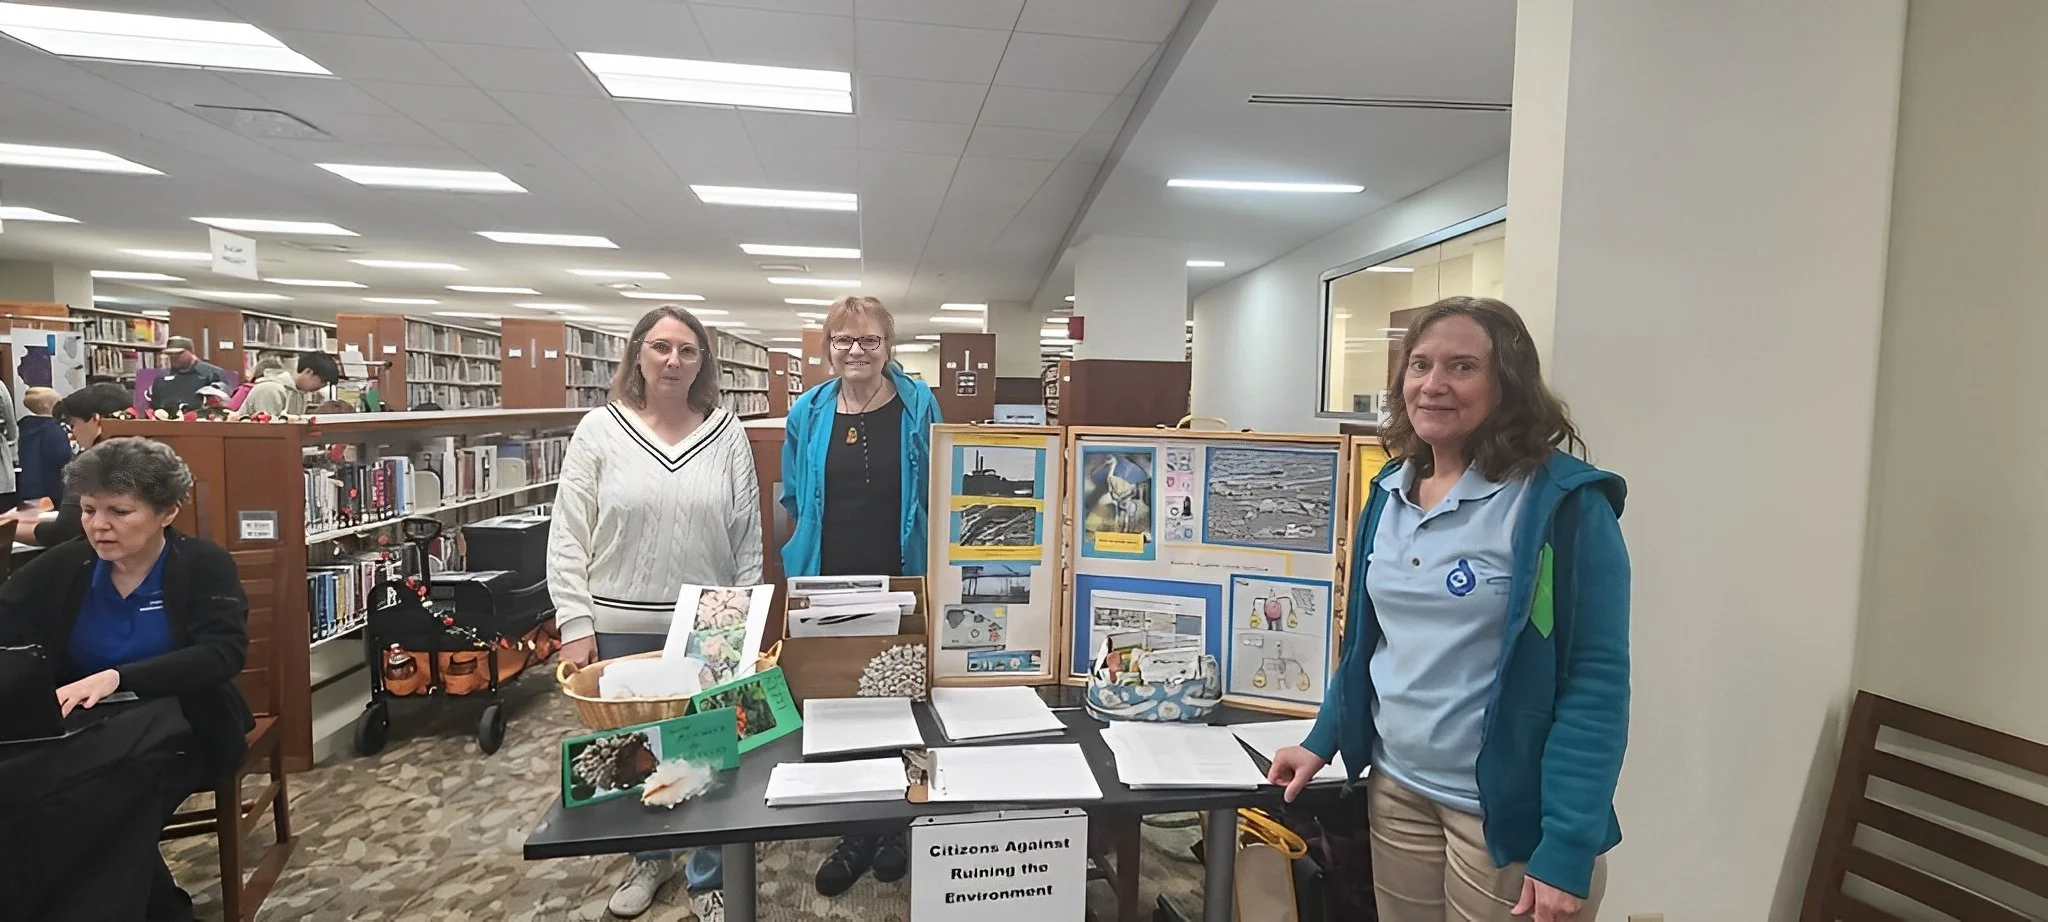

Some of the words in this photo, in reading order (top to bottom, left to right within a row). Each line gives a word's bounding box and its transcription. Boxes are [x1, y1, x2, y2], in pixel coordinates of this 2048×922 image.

[1005, 838, 1070, 854] Against
[951, 865, 1015, 880] Ruining
[1022, 863, 1048, 875] the
[945, 885, 1053, 904] Environment
